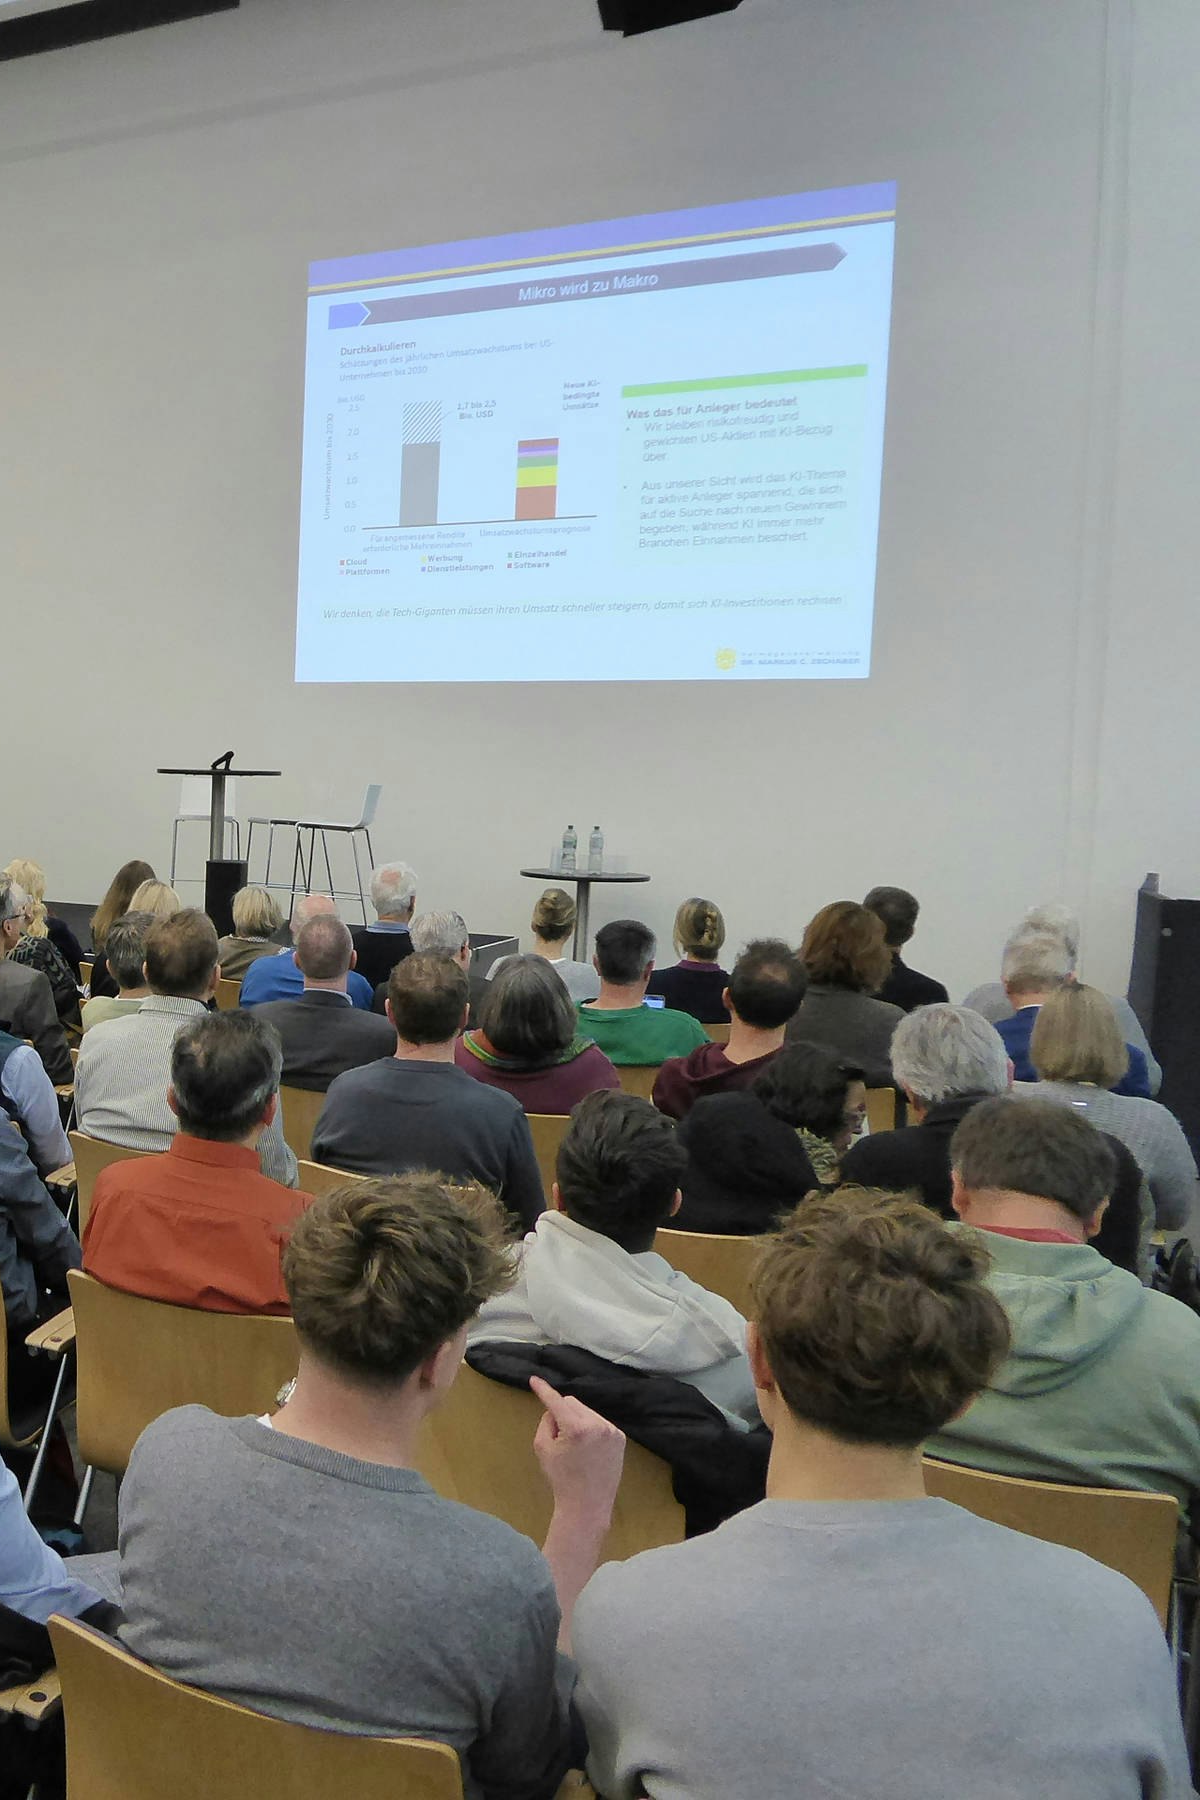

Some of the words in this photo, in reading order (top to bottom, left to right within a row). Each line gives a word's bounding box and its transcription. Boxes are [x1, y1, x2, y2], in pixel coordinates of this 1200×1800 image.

[518, 285, 557, 302] Mikro
[560, 280, 590, 297] wird
[593, 279, 610, 293] zu
[612, 273, 658, 290] Makro
[340, 339, 416, 356] Durchkalkulieren
[339, 368, 392, 382] Unternehmen
[626, 409, 649, 420] Was
[653, 407, 673, 418] das
[676, 405, 693, 416] für
[696, 402, 740, 418] Anleger
[745, 396, 798, 411] bedeutet
[645, 422, 662, 432] Wir
[641, 480, 662, 491] Aus
[665, 479, 705, 490] unserer
[709, 475, 736, 487] Sicht
[740, 474, 763, 484] wird
[766, 473, 786, 483] das
[790, 469, 846, 481] KI-Thema
[641, 494, 656, 505] für
[658, 493, 688, 504] aktive
[691, 491, 733, 505] Anleger
[798, 485, 816, 496] die
[819, 484, 842, 494] sich
[640, 509, 658, 520] auf
[661, 508, 676, 518] die
[679, 506, 713, 518] Suche
[716, 505, 742, 516] nach
[746, 503, 781, 514] neuen
[692, 520, 738, 532] während
[742, 519, 753, 529] KI
[757, 517, 792, 528] immer
[795, 515, 824, 526] mehr
[638, 536, 689, 548] Branchen
[693, 533, 754, 546] Einnahmen
[427, 553, 463, 564] Werbung
[514, 549, 568, 560] Einzelhandel
[346, 558, 368, 567] Cloud
[427, 563, 494, 574] Dienstleistungen
[513, 561, 550, 570] Software
[346, 567, 390, 576] Plattformen
[323, 607, 340, 619] Wir
[376, 606, 390, 618] die
[393, 606, 456, 620] Tech-Giganten
[458, 606, 495, 616] müssen
[496, 603, 521, 615] ihren
[522, 603, 560, 615] Umsatz
[562, 602, 605, 613] schneller
[654, 599, 685, 610] damit
[688, 598, 709, 609] sich
